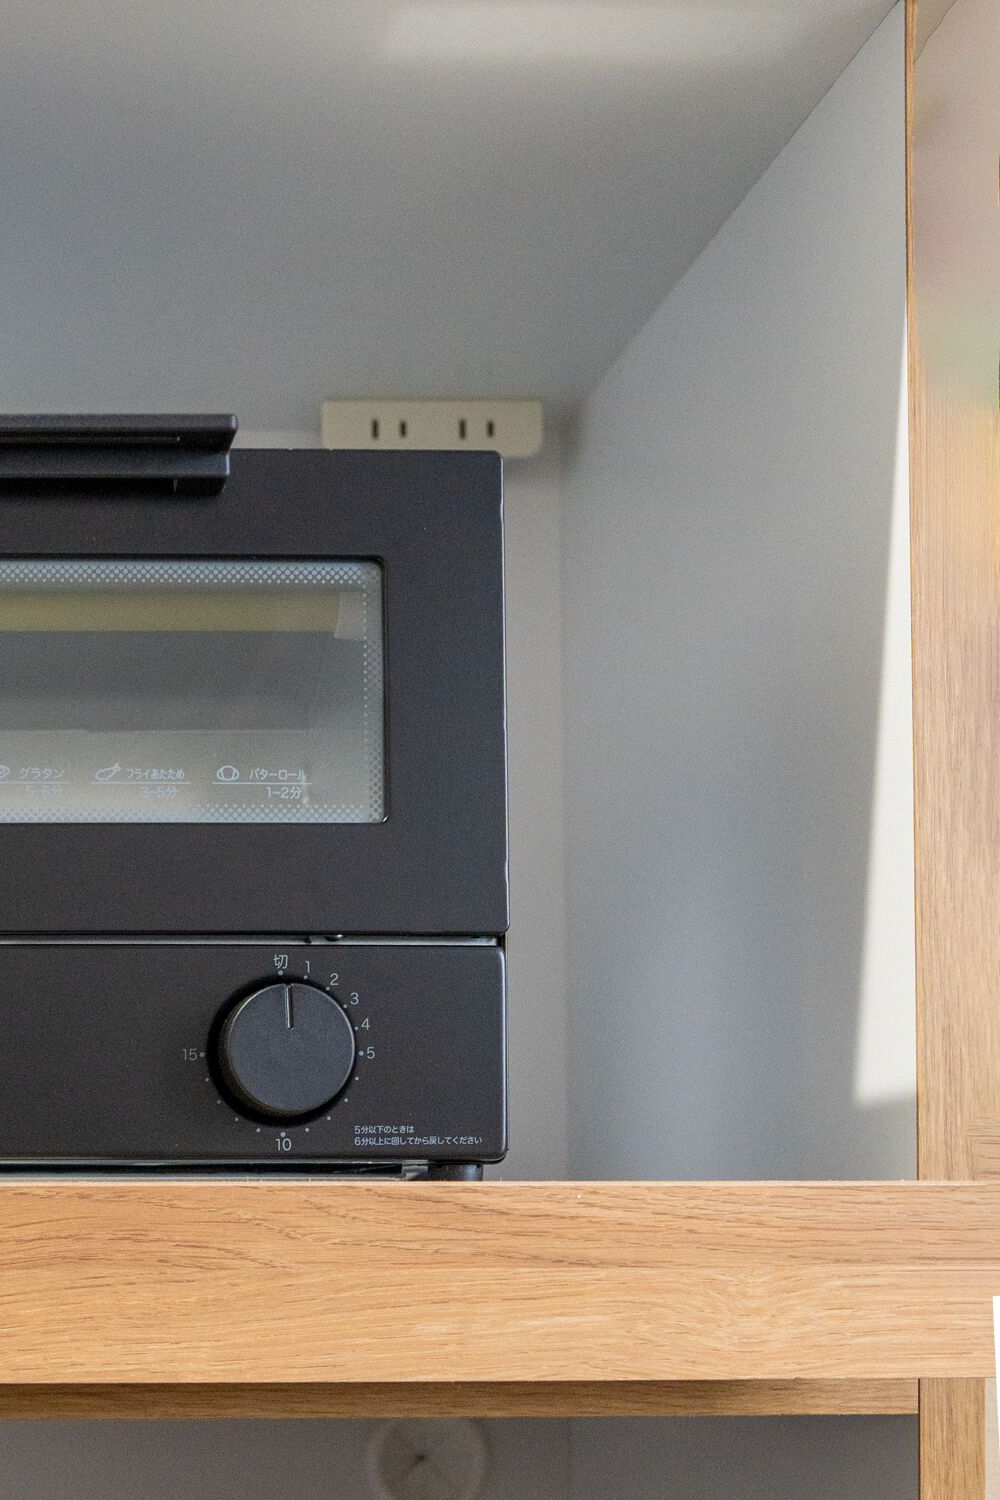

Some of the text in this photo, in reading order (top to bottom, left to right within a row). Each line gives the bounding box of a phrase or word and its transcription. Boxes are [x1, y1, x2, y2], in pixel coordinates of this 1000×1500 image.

[19, 766, 65, 780] グラタン
[126, 768, 186, 781] フライあたため
[273, 954, 288, 969] 切
[330, 973, 339, 986] 2
[350, 993, 359, 1005] 3
[361, 1018, 370, 1030] 4
[182, 1048, 198, 1061] 15
[366, 1047, 375, 1059] 5
[354, 1125, 415, 1135] 5分以下のときは
[275, 1138, 292, 1151] 10
[354, 1136, 483, 1146] 6分以上に回してから戻してください
